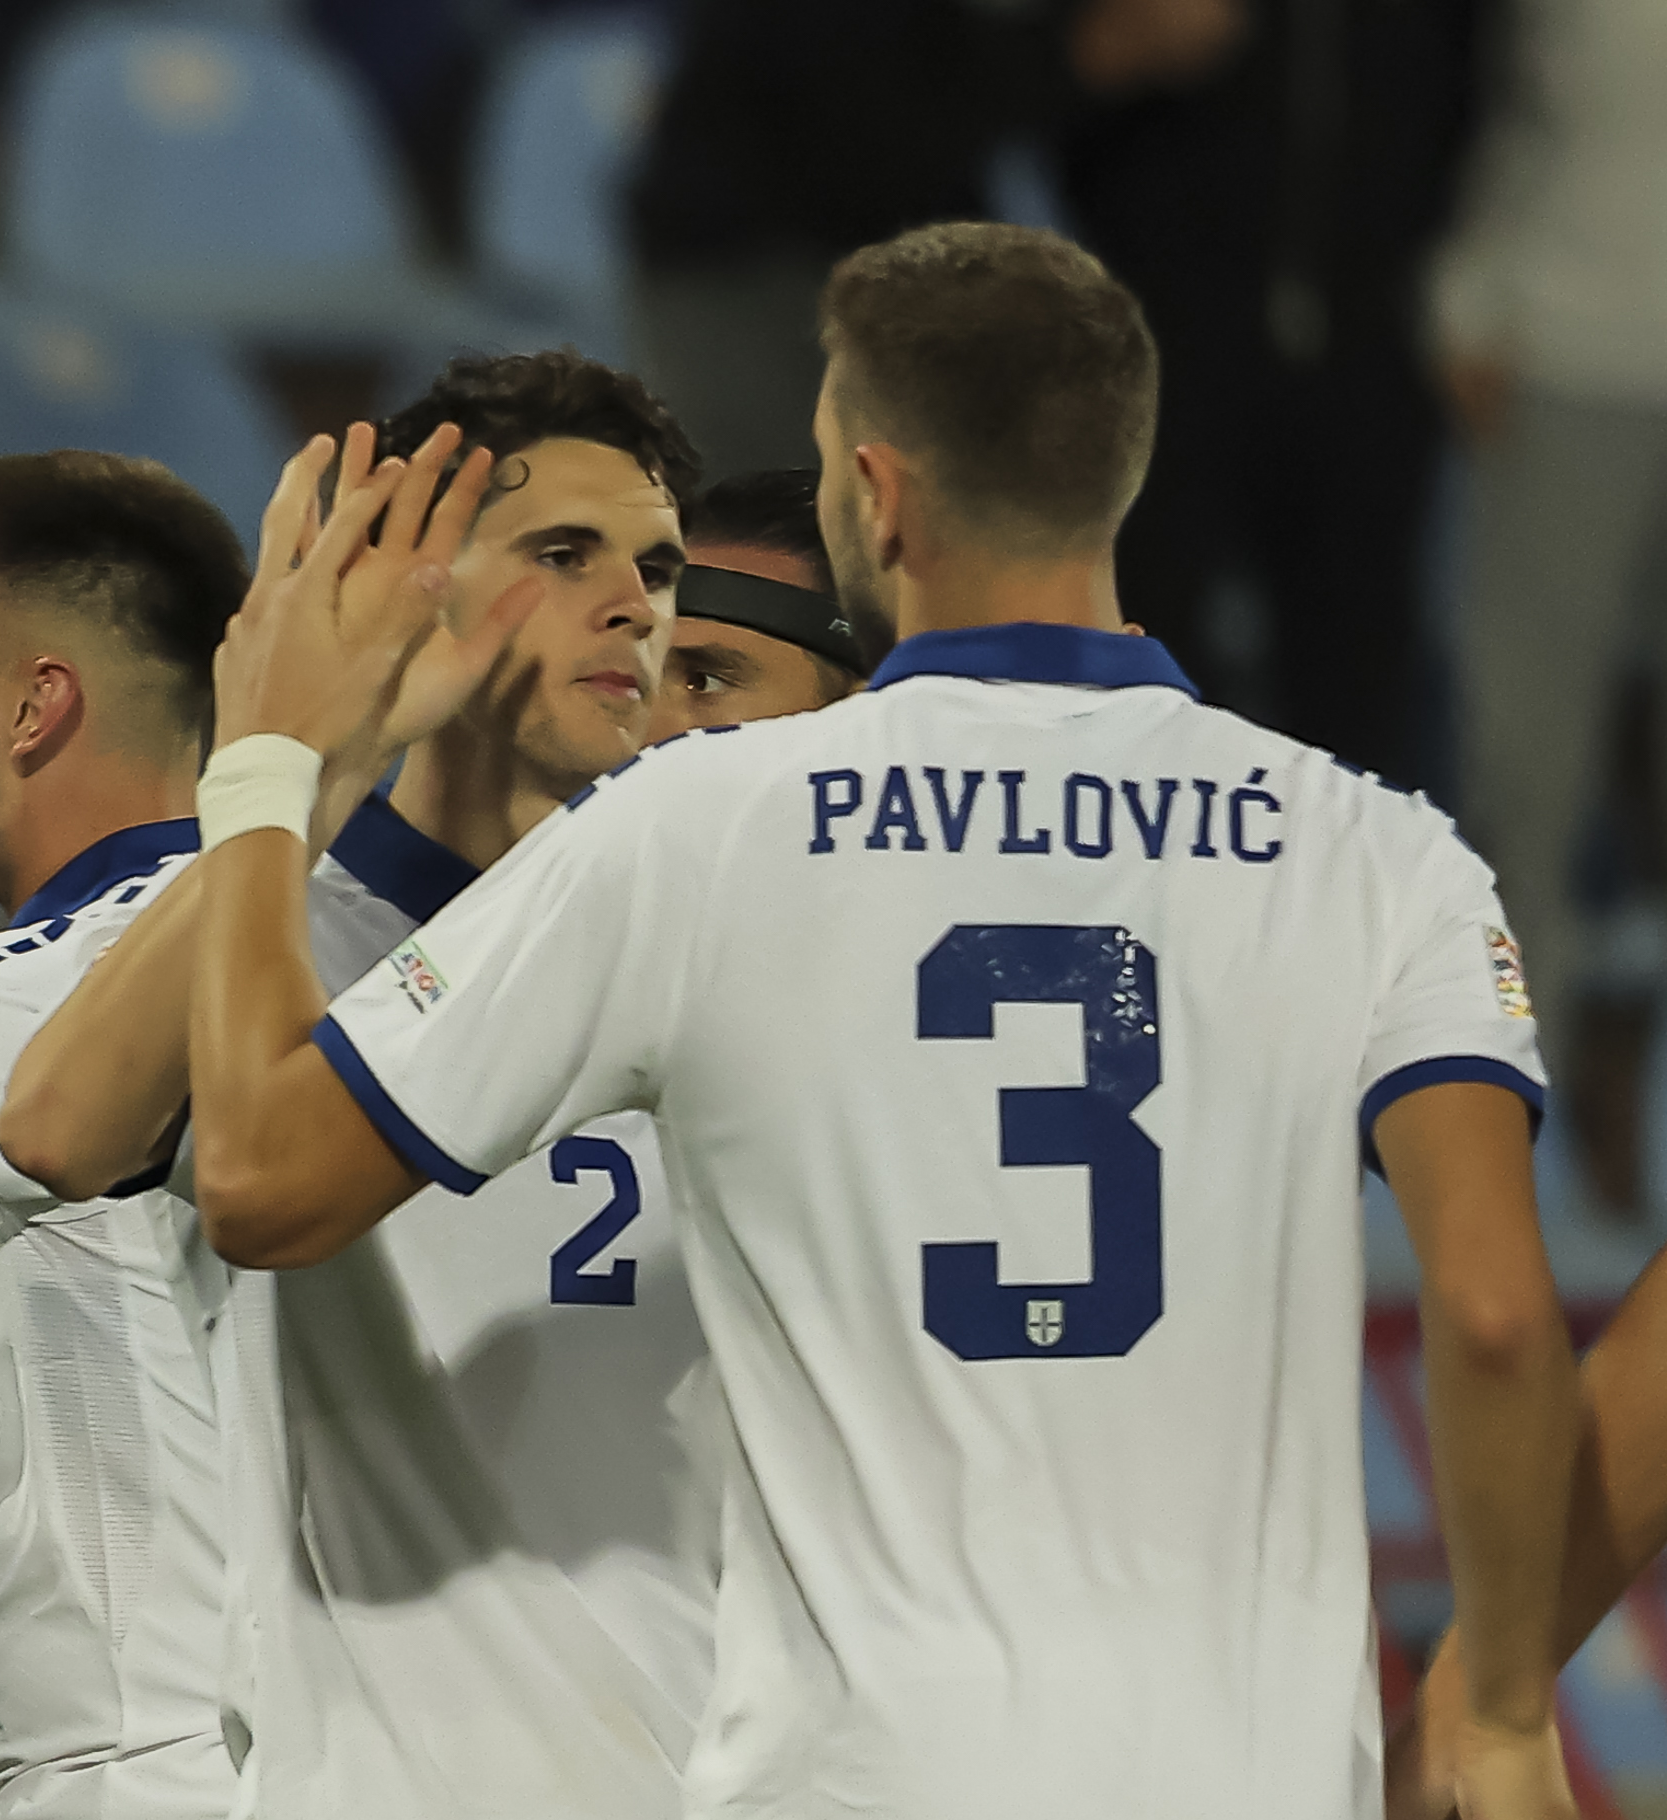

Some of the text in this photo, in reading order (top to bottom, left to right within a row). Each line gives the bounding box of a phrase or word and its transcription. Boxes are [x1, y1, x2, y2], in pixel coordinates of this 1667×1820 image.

[806, 765, 1283, 862] PAVLOVIĆ
[548, 1136, 640, 1306] 2
[917, 923, 1164, 1362] 3
